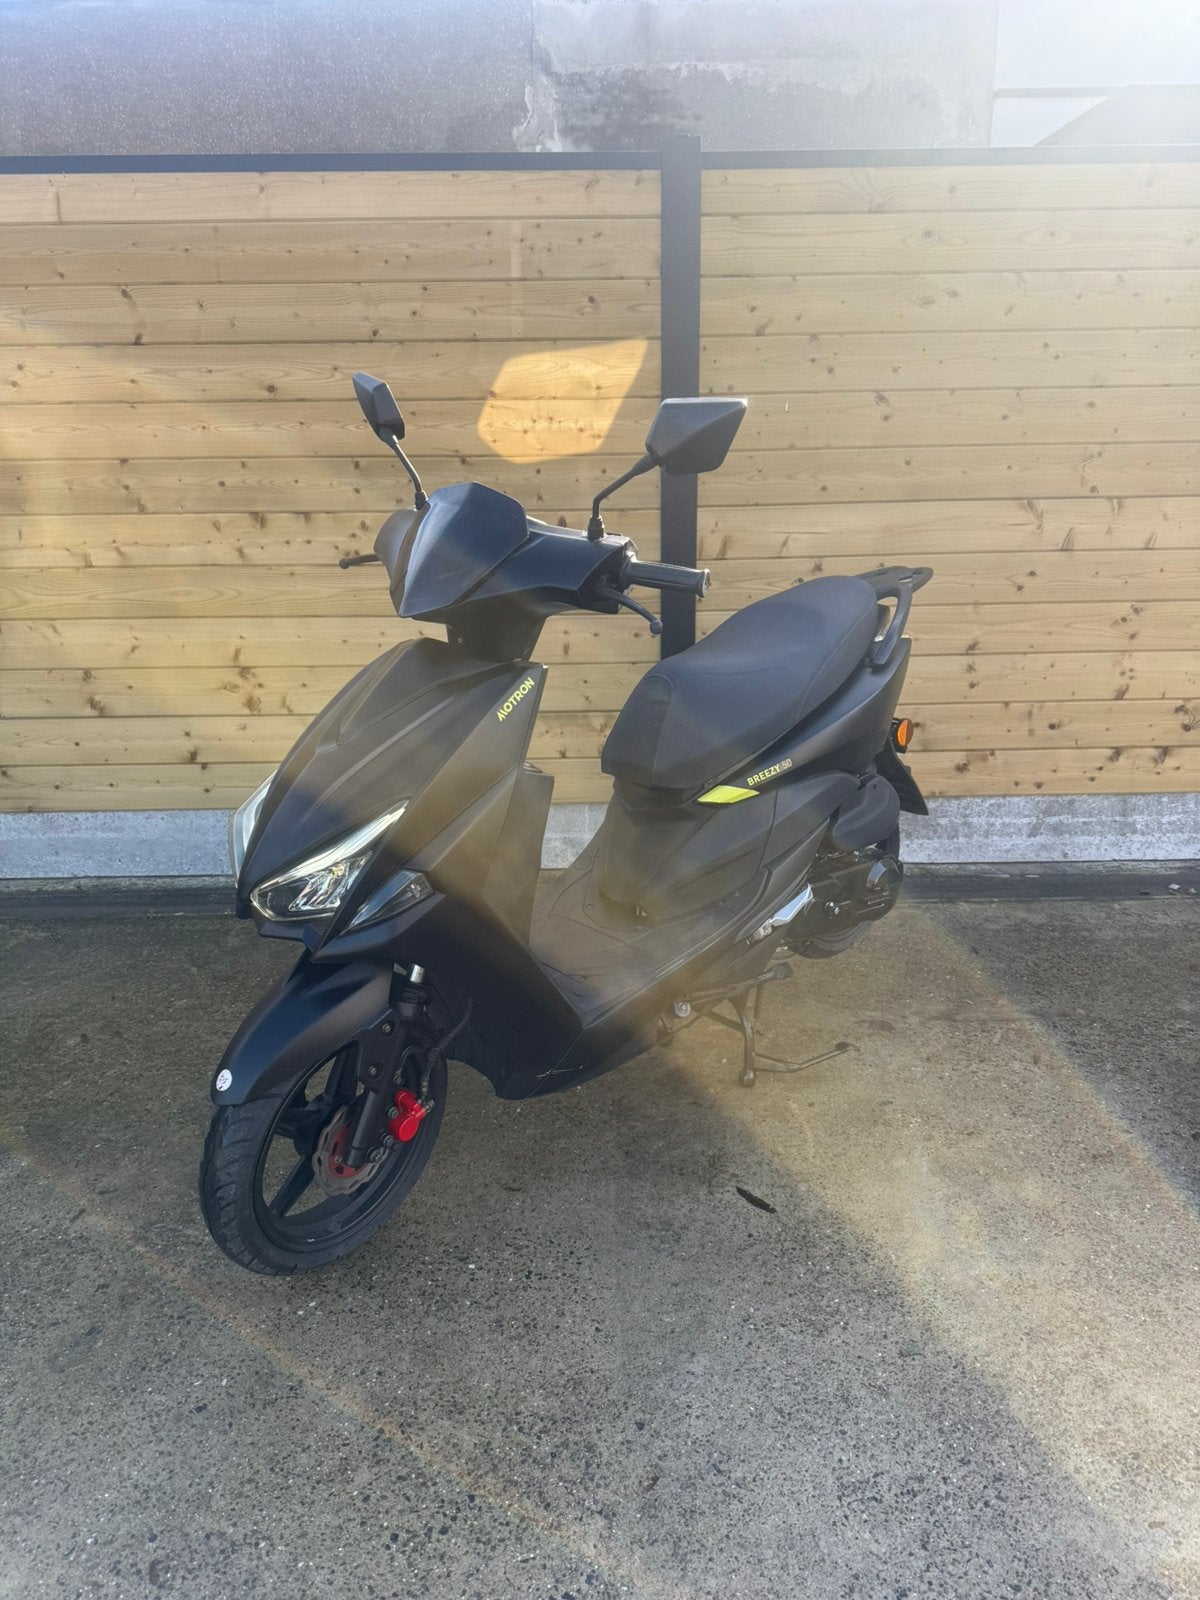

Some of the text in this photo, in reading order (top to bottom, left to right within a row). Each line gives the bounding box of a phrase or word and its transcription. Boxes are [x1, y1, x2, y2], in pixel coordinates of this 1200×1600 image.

[496, 676, 535, 722] MOTRON
[746, 758, 793, 786] BREEZY 50
